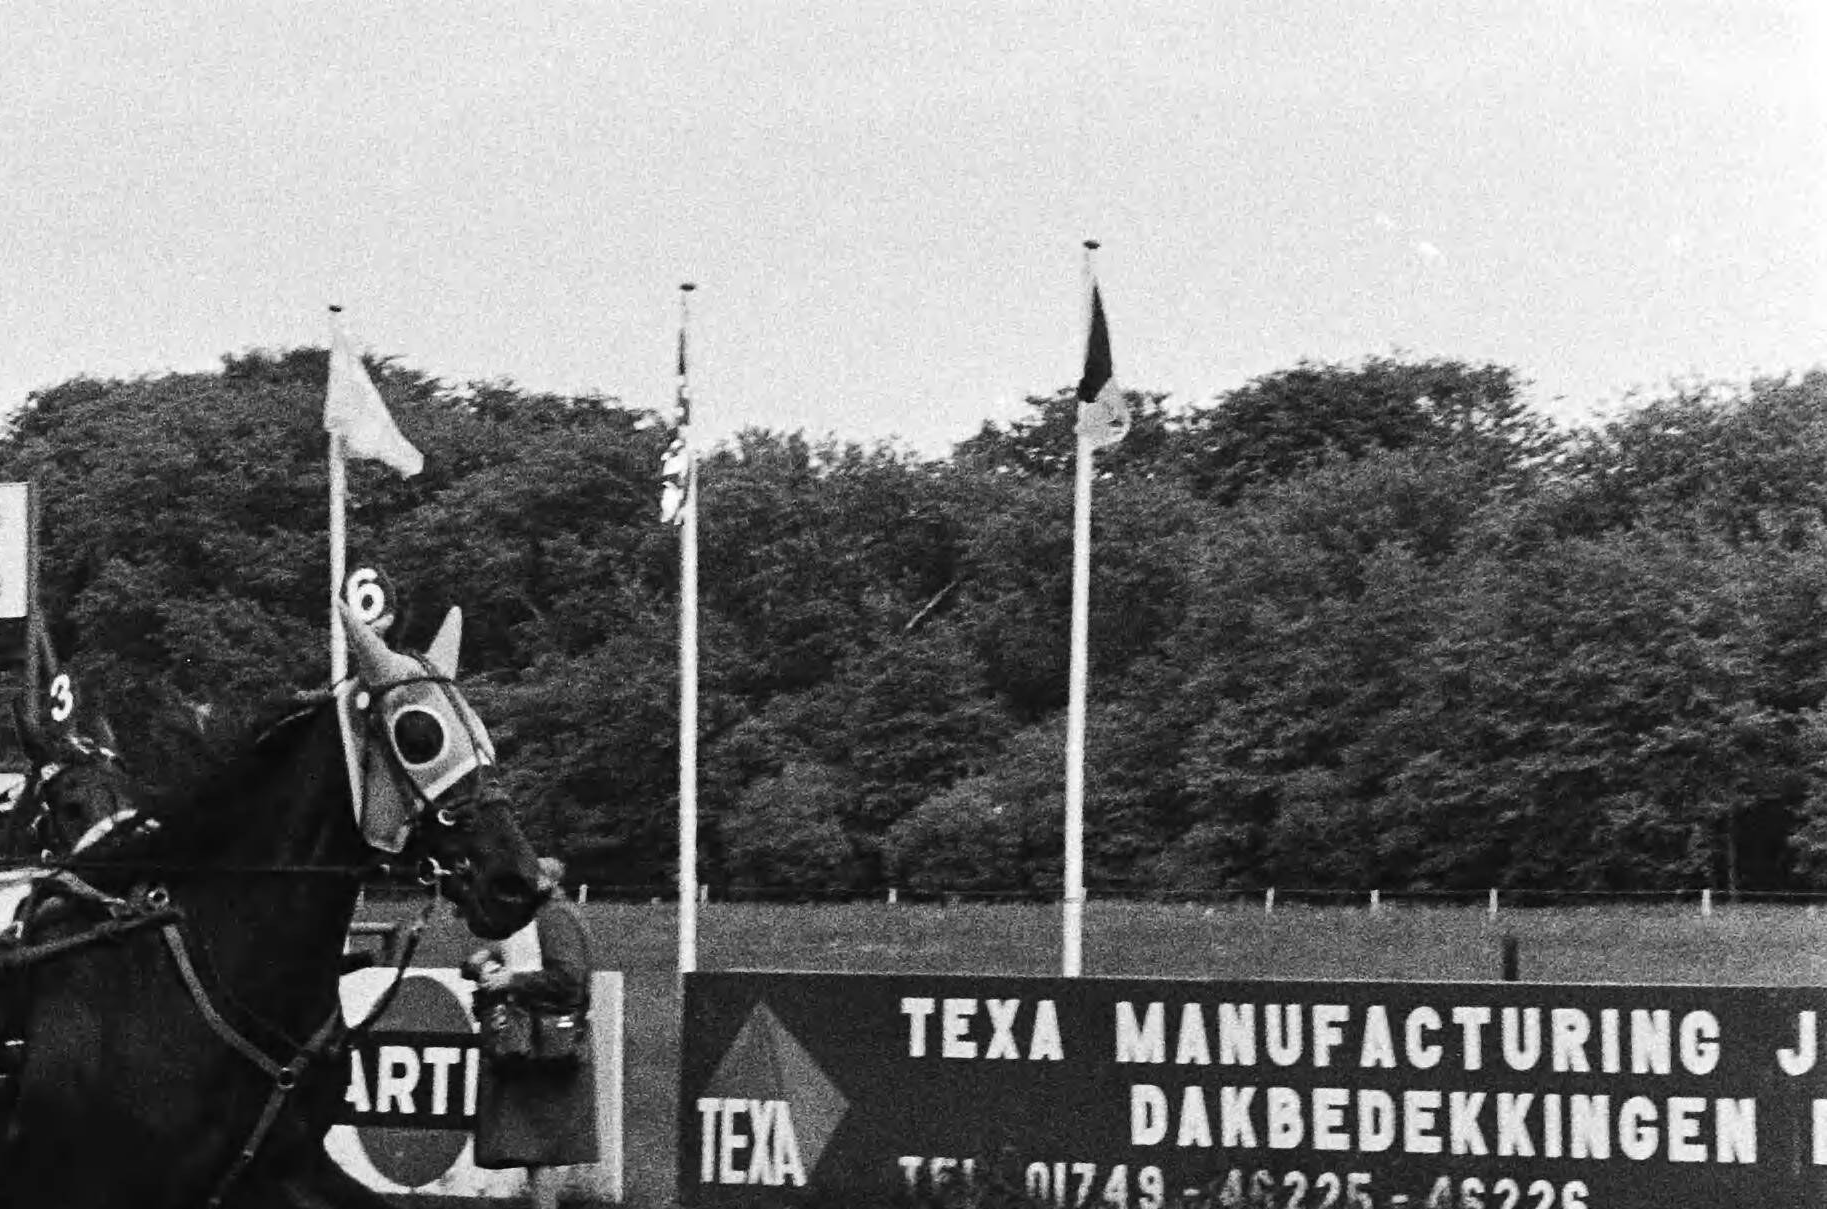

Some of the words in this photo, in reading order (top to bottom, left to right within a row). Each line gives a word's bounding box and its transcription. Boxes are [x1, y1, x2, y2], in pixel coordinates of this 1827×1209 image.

[347, 567, 385, 624] 6
[50, 674, 74, 722] 3
[901, 997, 1065, 1061] TEXA
[1115, 1001, 1721, 1076] MANUFACTURING
[696, 1097, 809, 1187] TEXA
[1131, 1084, 1758, 1164] DAKBEDEKKINGEN
